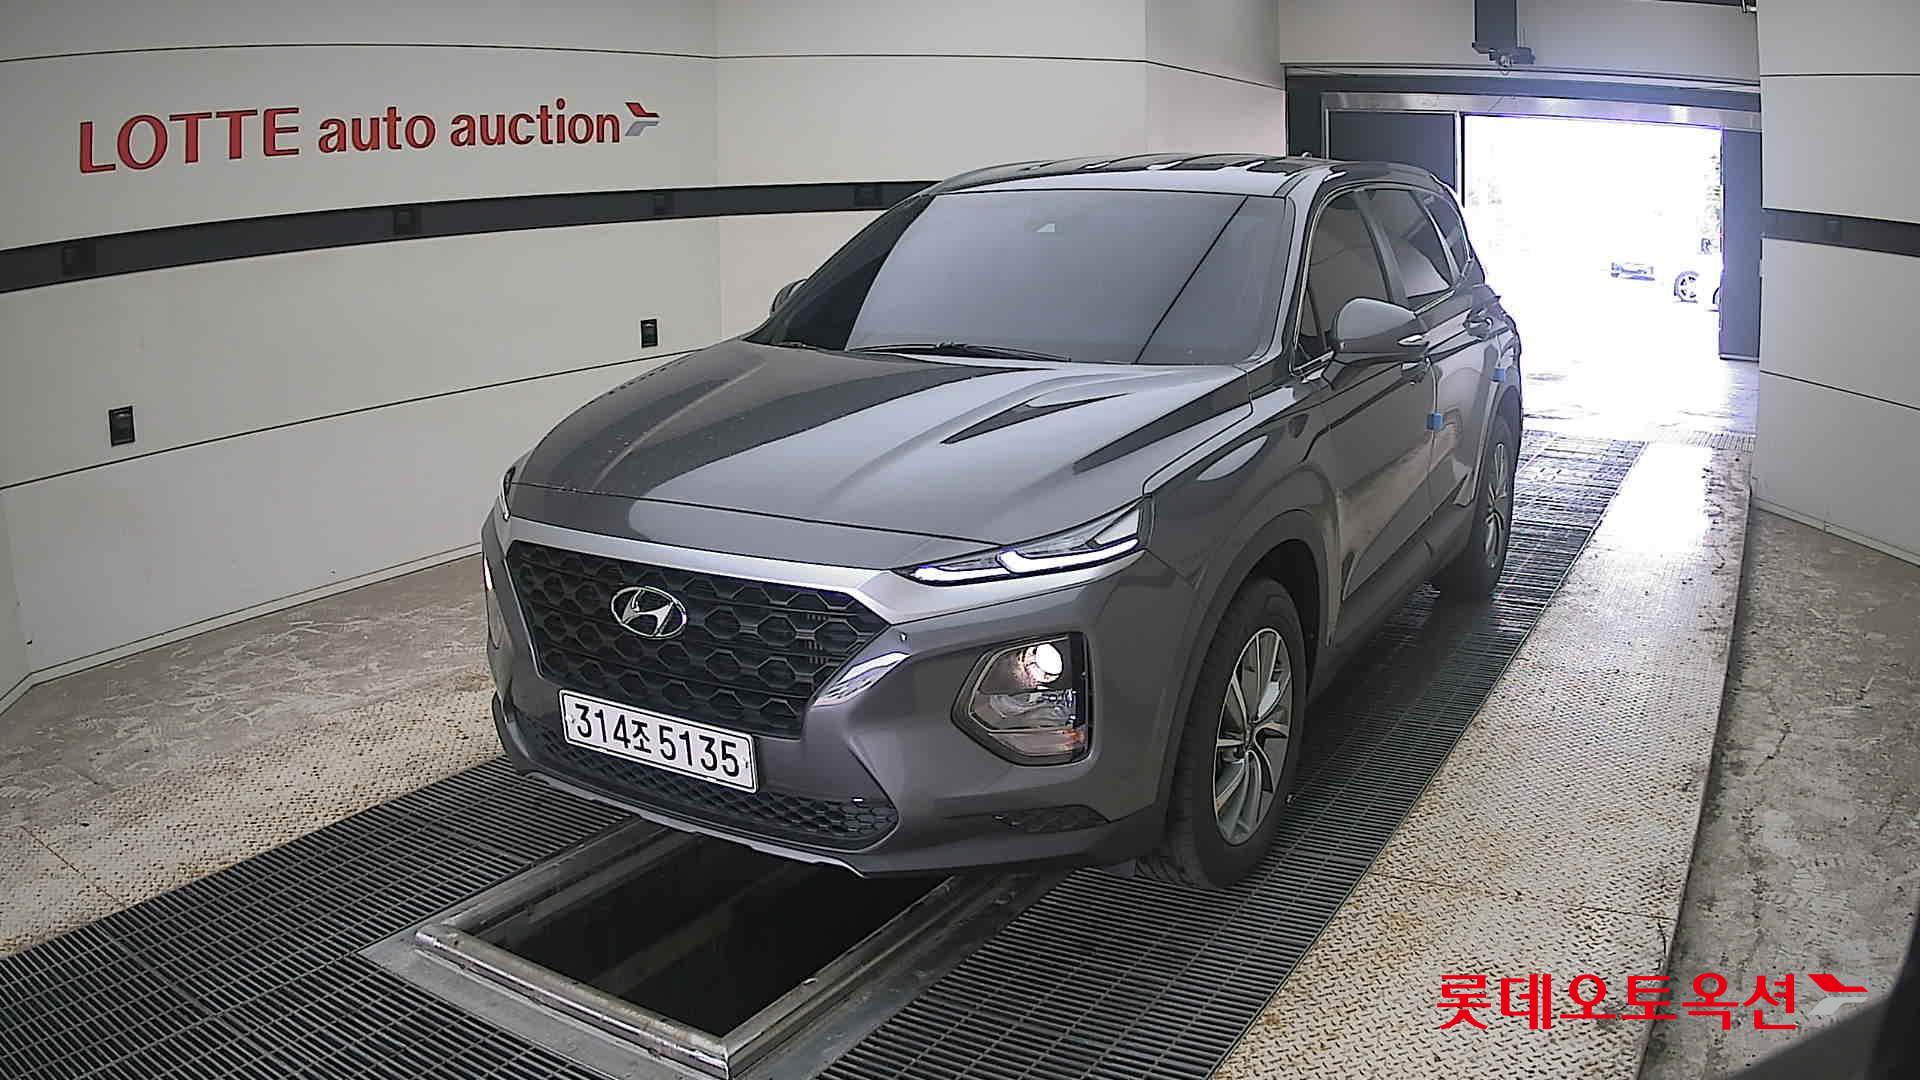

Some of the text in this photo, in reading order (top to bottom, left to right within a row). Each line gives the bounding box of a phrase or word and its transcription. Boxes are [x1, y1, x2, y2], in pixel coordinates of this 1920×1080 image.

[79, 98, 620, 174] LOTTE auto auction
[658, 724, 740, 777] 5135
